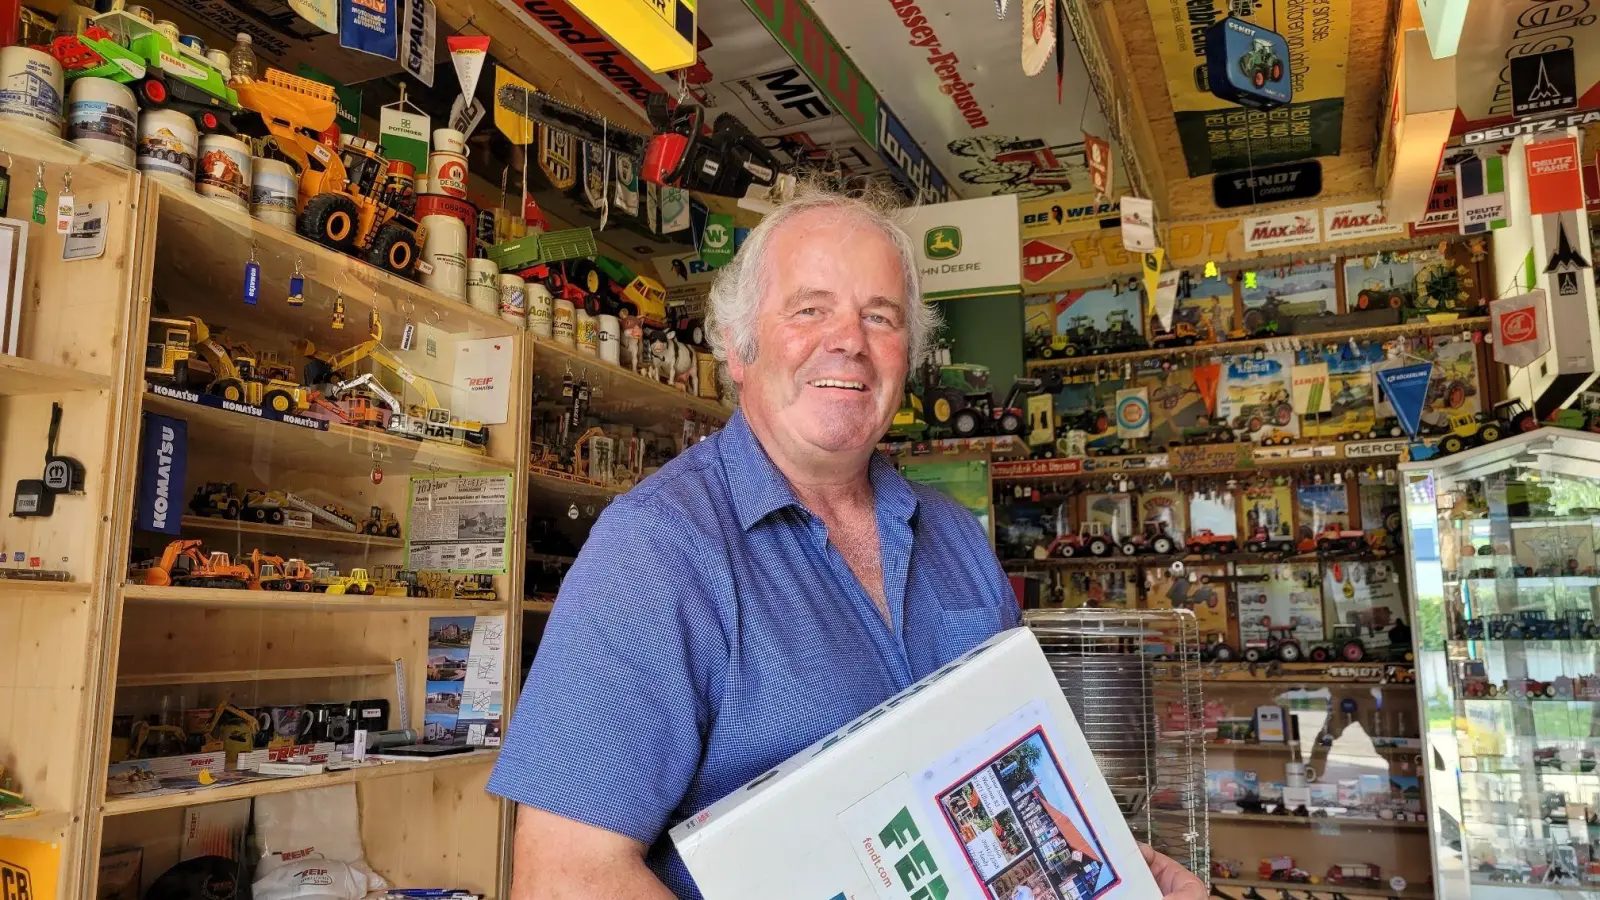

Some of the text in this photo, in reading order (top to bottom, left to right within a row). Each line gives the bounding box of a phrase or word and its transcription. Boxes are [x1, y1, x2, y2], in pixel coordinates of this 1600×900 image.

[524, 0, 604, 46] und
[757, 68, 831, 119] MF
[1516, 97, 1575, 112] DEUTZ
[1531, 156, 1574, 169] DEUTZ
[1536, 163, 1570, 174] FAHR
[1233, 170, 1302, 191] FENDT
[1024, 211, 1049, 225] BE
[1426, 212, 1449, 223] ASE
[1466, 205, 1504, 217] DEUTZ
[1470, 211, 1501, 222] FAHR
[941, 262, 981, 274] DEERE
[469, 377, 494, 387] REIF
[153, 384, 199, 403] KOMATSU
[222, 400, 262, 416] KOMATSU
[283, 414, 319, 429] KOMATSU
[153, 426, 175, 529] KOMATSU
[281, 847, 314, 861] REIF
[862, 837, 893, 889] fendt.com
[301, 868, 328, 878] REIF
